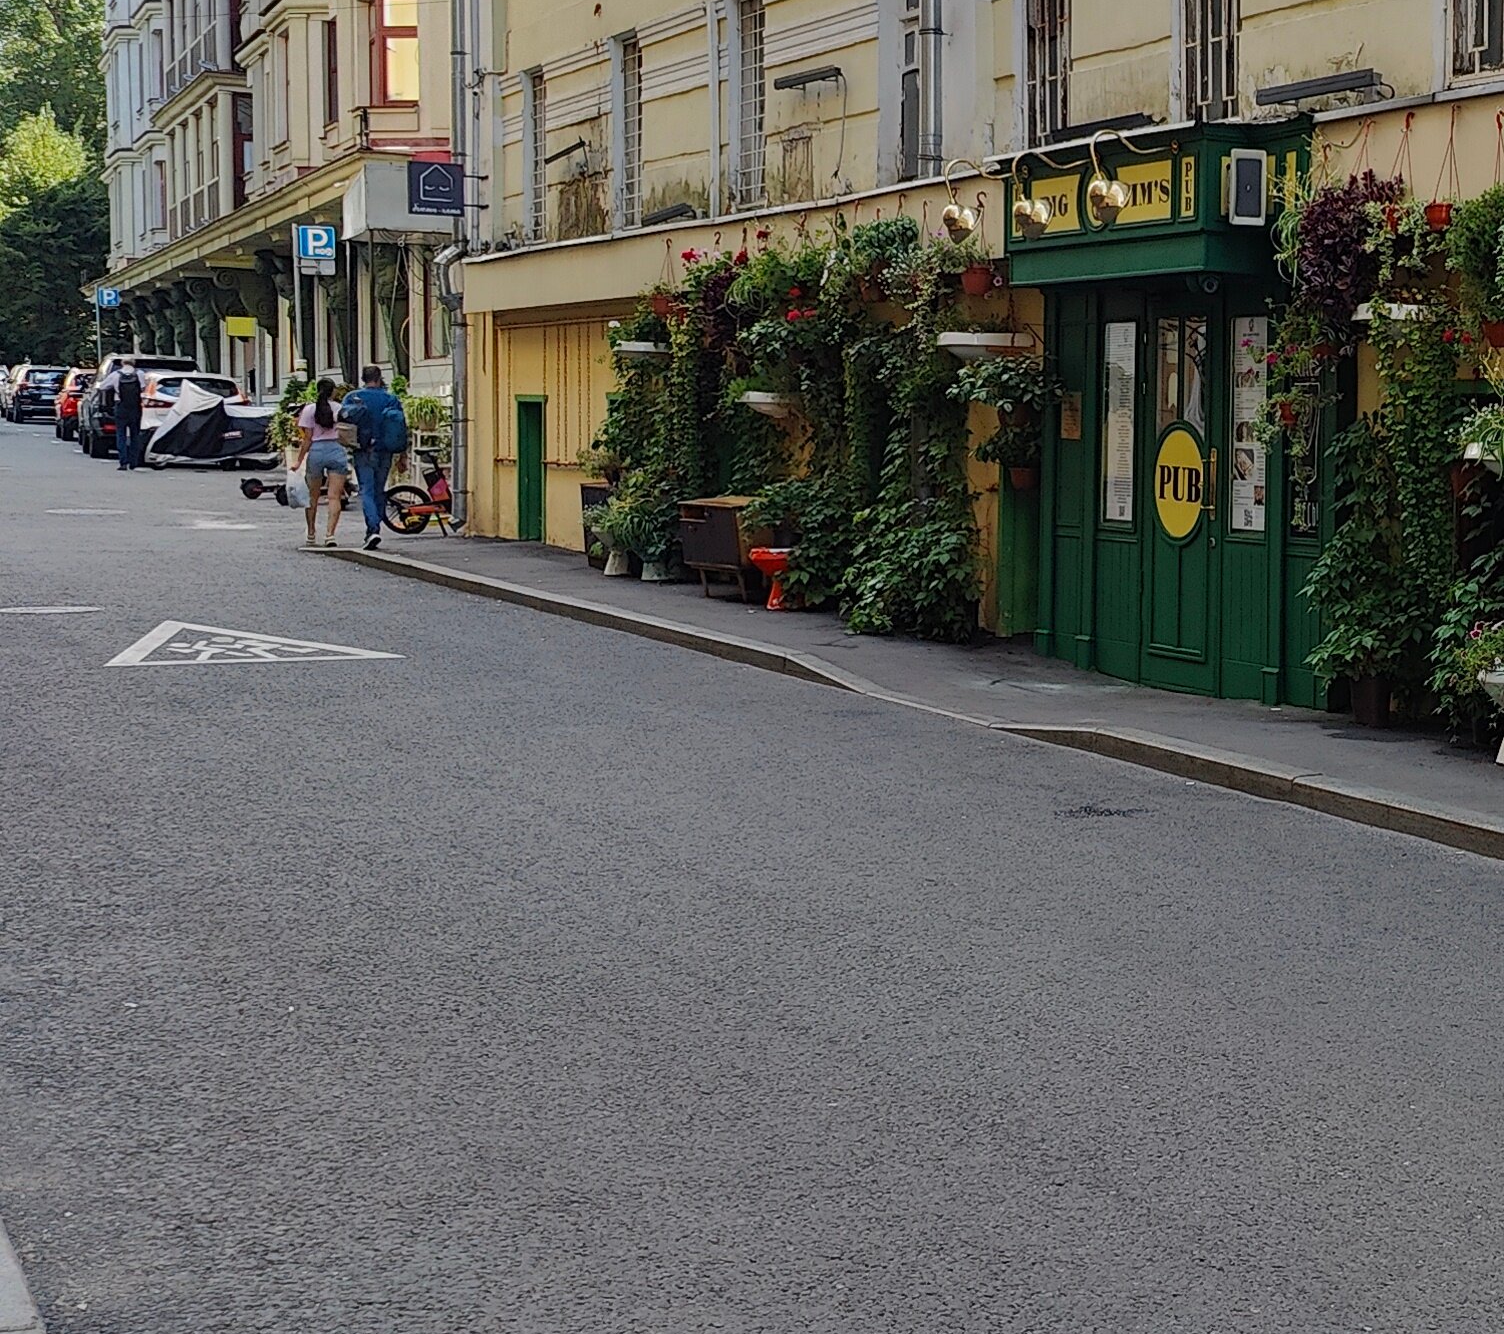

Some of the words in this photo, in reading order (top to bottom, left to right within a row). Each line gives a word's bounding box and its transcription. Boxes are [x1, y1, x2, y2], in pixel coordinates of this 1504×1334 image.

[1124, 178, 1170, 208] IM'S
[1185, 161, 1193, 212] PUB
[307, 229, 329, 256] P
[103, 290, 116, 305] P
[1158, 465, 1201, 503] PUB
